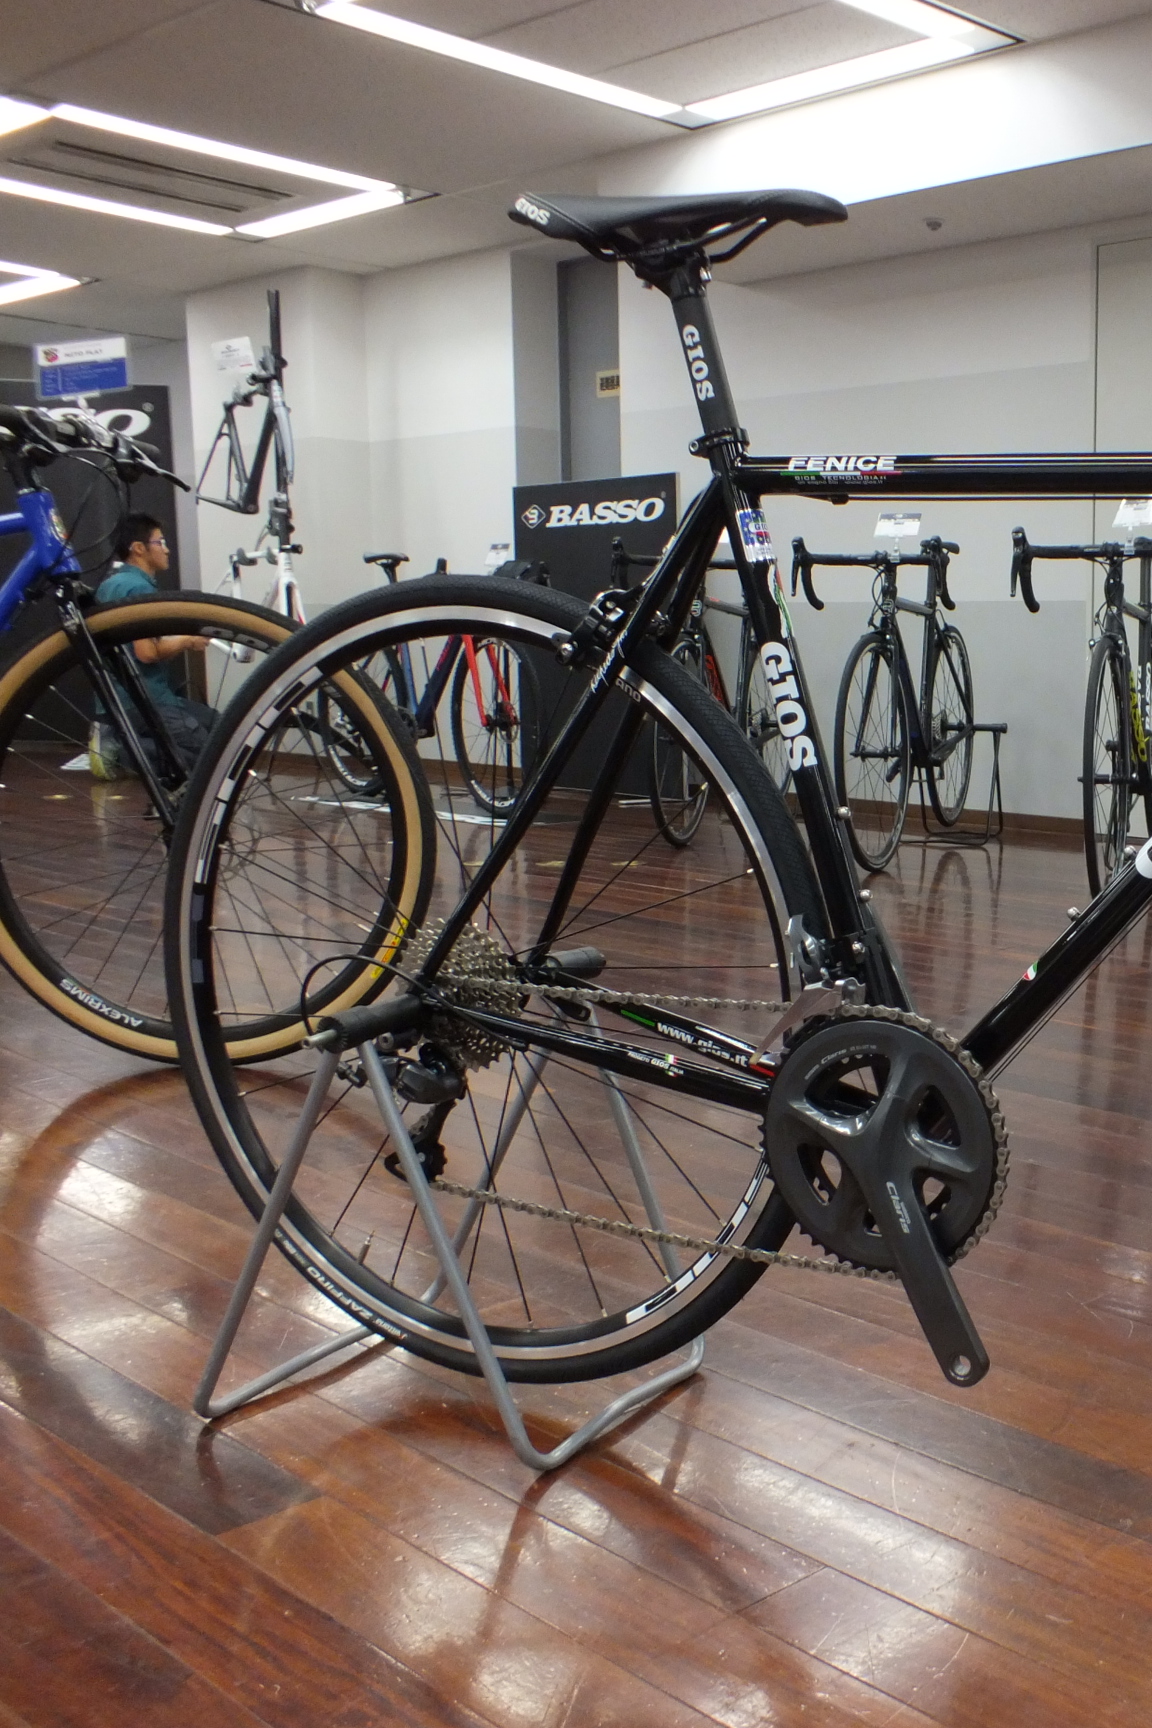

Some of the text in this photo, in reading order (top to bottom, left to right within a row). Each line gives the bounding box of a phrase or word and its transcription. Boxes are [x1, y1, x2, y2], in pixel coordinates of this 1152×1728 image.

[514, 198, 551, 226] GIOS
[682, 324, 715, 402] GIOS
[788, 456, 897, 472] FENICE
[546, 497, 665, 528] BASSO
[761, 641, 818, 771] GIOS
[60, 977, 143, 1028] ALEXRIMS
[886, 1182, 910, 1234] Claris
[307, 1266, 373, 1319] ZAFFIRO
